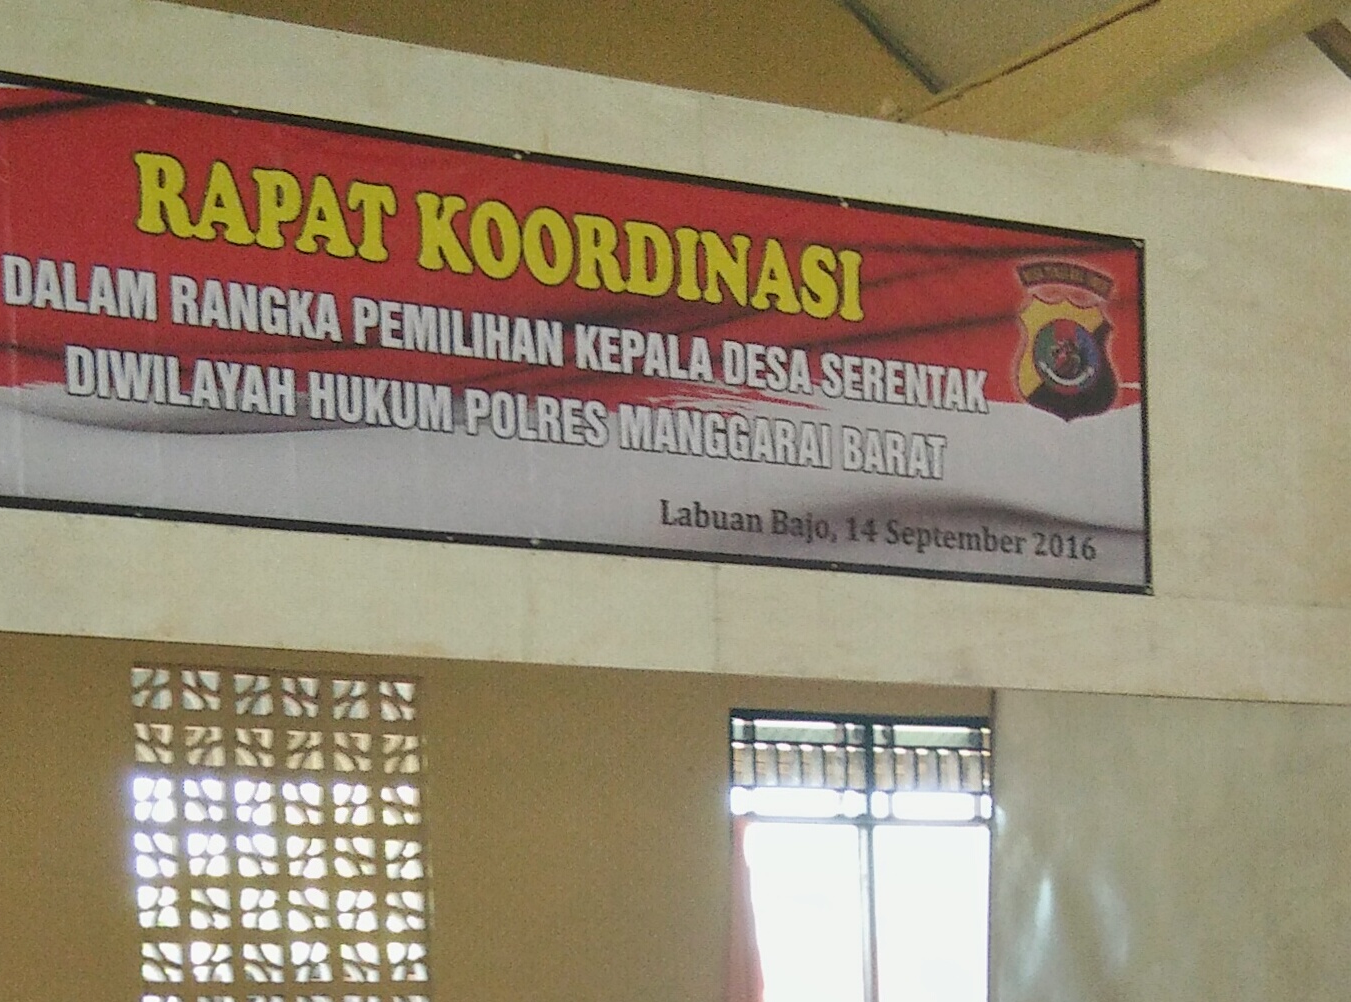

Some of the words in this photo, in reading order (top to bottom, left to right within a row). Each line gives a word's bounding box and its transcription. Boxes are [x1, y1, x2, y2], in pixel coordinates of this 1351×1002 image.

[133, 150, 398, 263] RAPAT
[415, 190, 865, 323] KOORDINASI
[2, 254, 157, 321] DALAM
[169, 274, 343, 342] RANGKA
[352, 296, 564, 367] PEMILIHAN
[574, 322, 713, 383] KEPALA
[721, 340, 813, 395] DESA
[820, 352, 989, 413] SERENTAK
[65, 344, 297, 417] DIWILAYAH
[308, 371, 453, 432] HUKUM
[464, 388, 609, 447] POLRES
[619, 403, 832, 469] MANGGARAI
[842, 425, 947, 479] BARAT
[659, 499, 763, 534] Labuan
[770, 509, 837, 544] Bajo,
[847, 515, 877, 543] 14
[886, 519, 1028, 554] September
[1034, 532, 1097, 561] 2016
